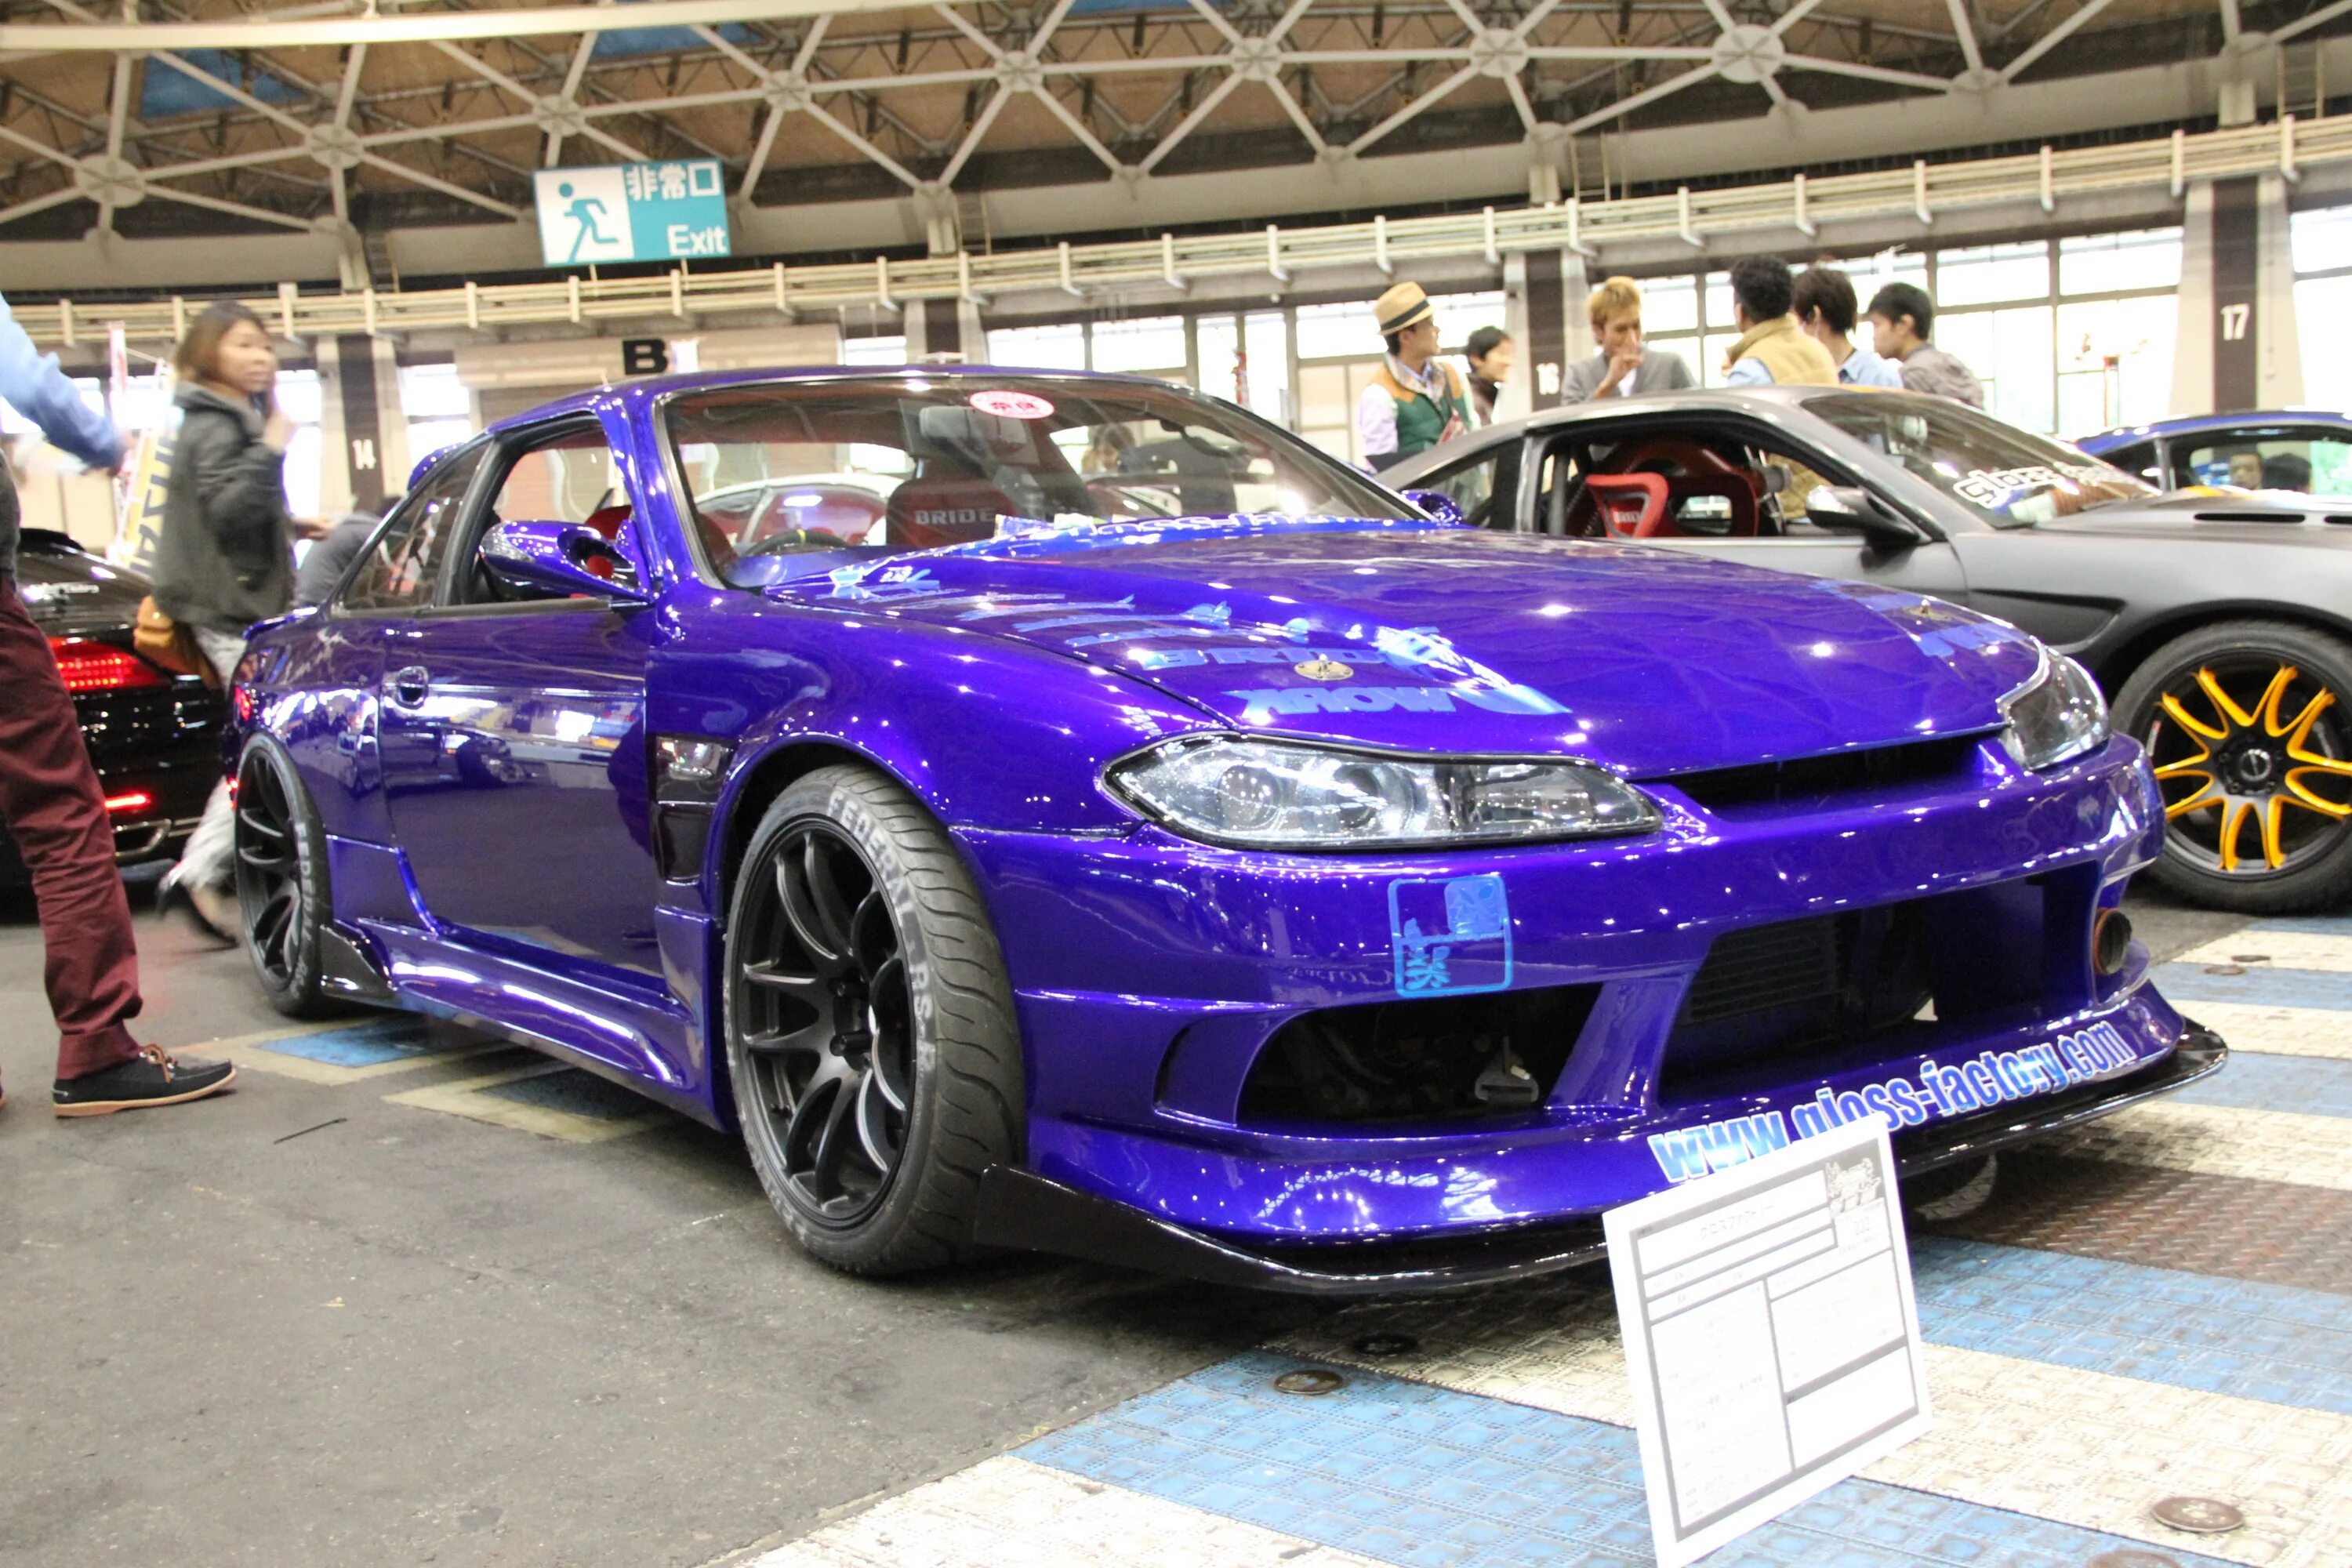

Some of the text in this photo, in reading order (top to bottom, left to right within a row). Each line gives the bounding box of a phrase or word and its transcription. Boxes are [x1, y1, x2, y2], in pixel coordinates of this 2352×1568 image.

[626, 162, 721, 201] 非常口
[667, 224, 728, 256] Exit
[2220, 303, 2249, 340] 17
[622, 339, 668, 376] B
[1536, 362, 1559, 395] 16
[352, 439, 376, 470] 14
[913, 509, 993, 525] BRIDE
[827, 789, 916, 927] FEDERAL
[1646, 1021, 2138, 1184] wwwgloss-factory.com
